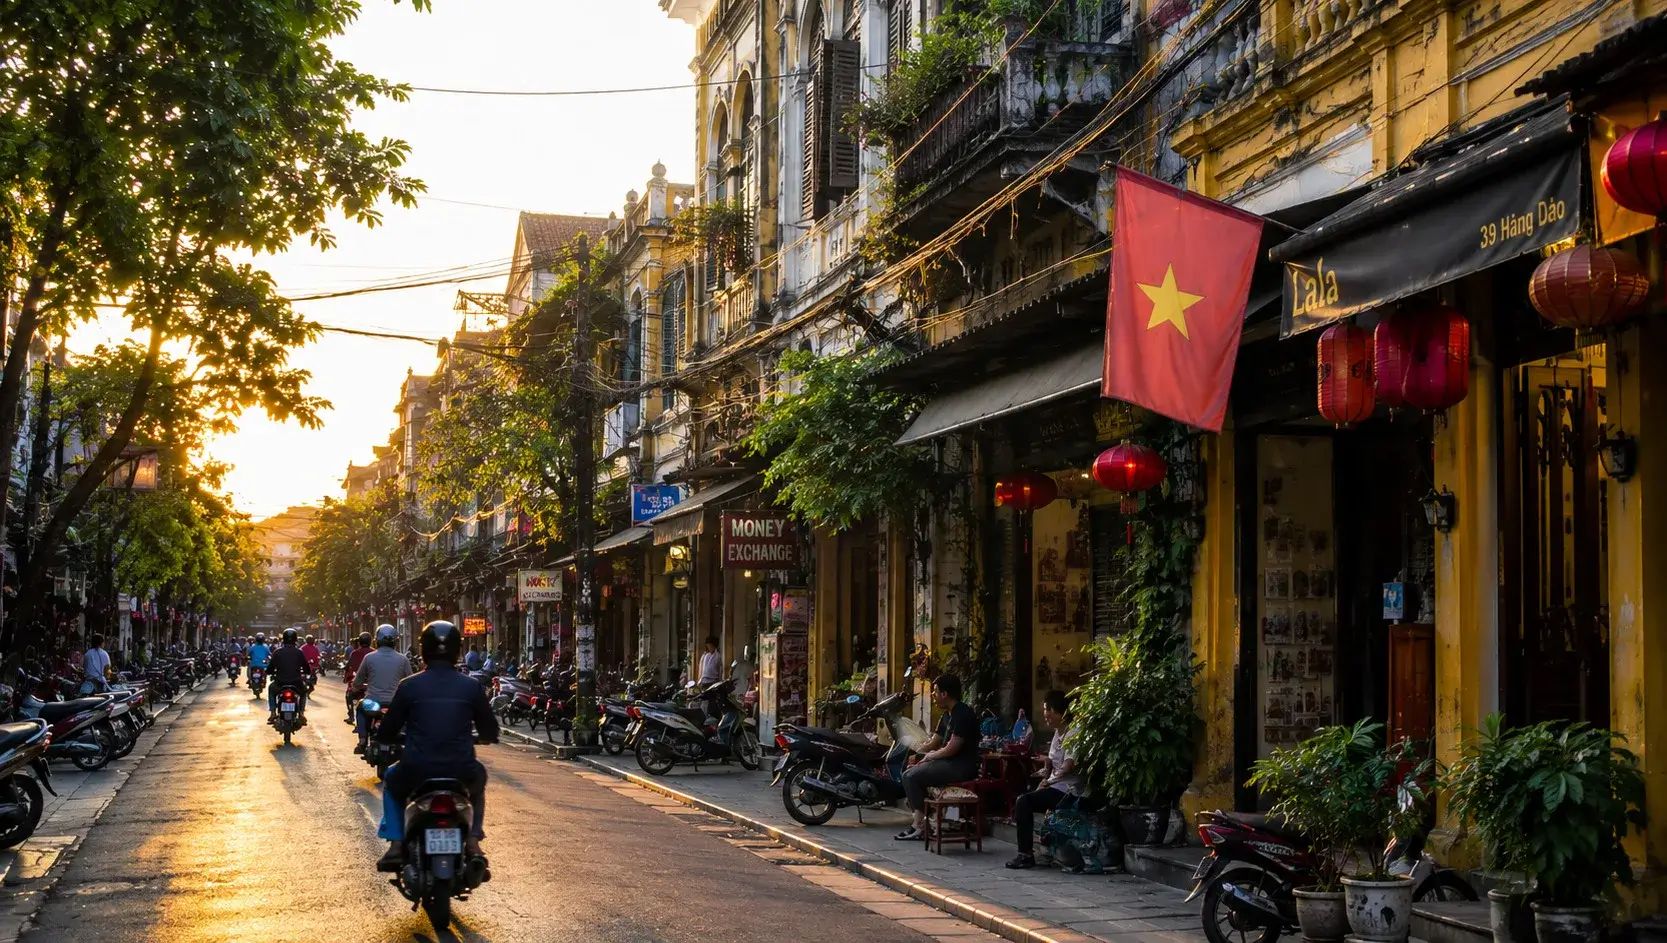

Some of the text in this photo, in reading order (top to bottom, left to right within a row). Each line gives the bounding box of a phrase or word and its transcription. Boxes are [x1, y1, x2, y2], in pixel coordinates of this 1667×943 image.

[1480, 223, 1496, 248] 39
[1291, 256, 1339, 317] Lala
[731, 518, 785, 537] MONEY
[728, 544, 793, 561] EXCHANGE
